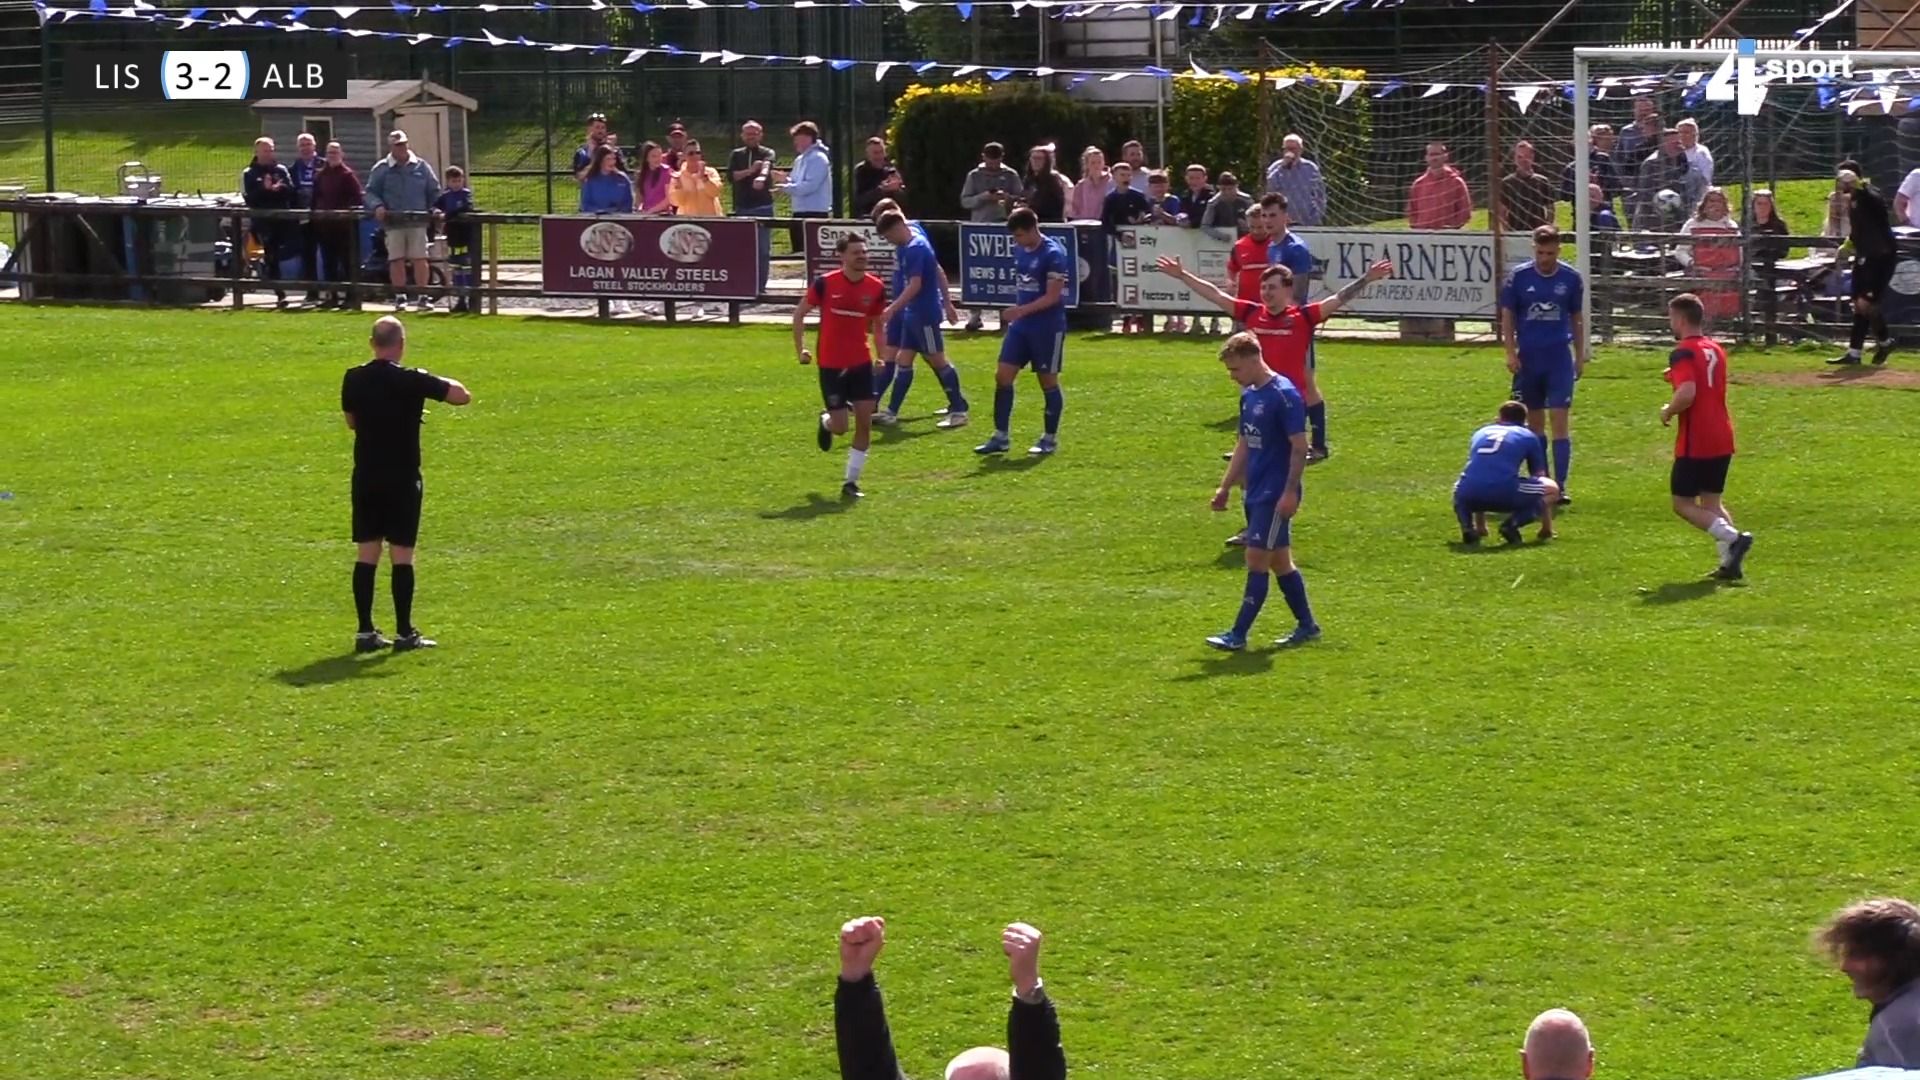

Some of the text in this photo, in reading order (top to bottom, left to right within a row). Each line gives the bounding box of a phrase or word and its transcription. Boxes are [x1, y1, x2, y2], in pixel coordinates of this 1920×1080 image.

[1139, 235, 1157, 248] city
[1124, 258, 1136, 275] E
[1336, 241, 1493, 283] KEARNEYS
[569, 265, 729, 282] LAGAN VALLEY STEELS
[969, 266, 996, 280] NEWS
[998, 267, 1006, 280] &
[592, 281, 706, 293] STEEL STOCKHOLDERS
[1125, 287, 1190, 302] F factors ltd
[1416, 286, 1443, 301] AND
[1444, 287, 1483, 302] PAINTS
[1703, 348, 1718, 389] 7
[1477, 428, 1508, 454] 3
